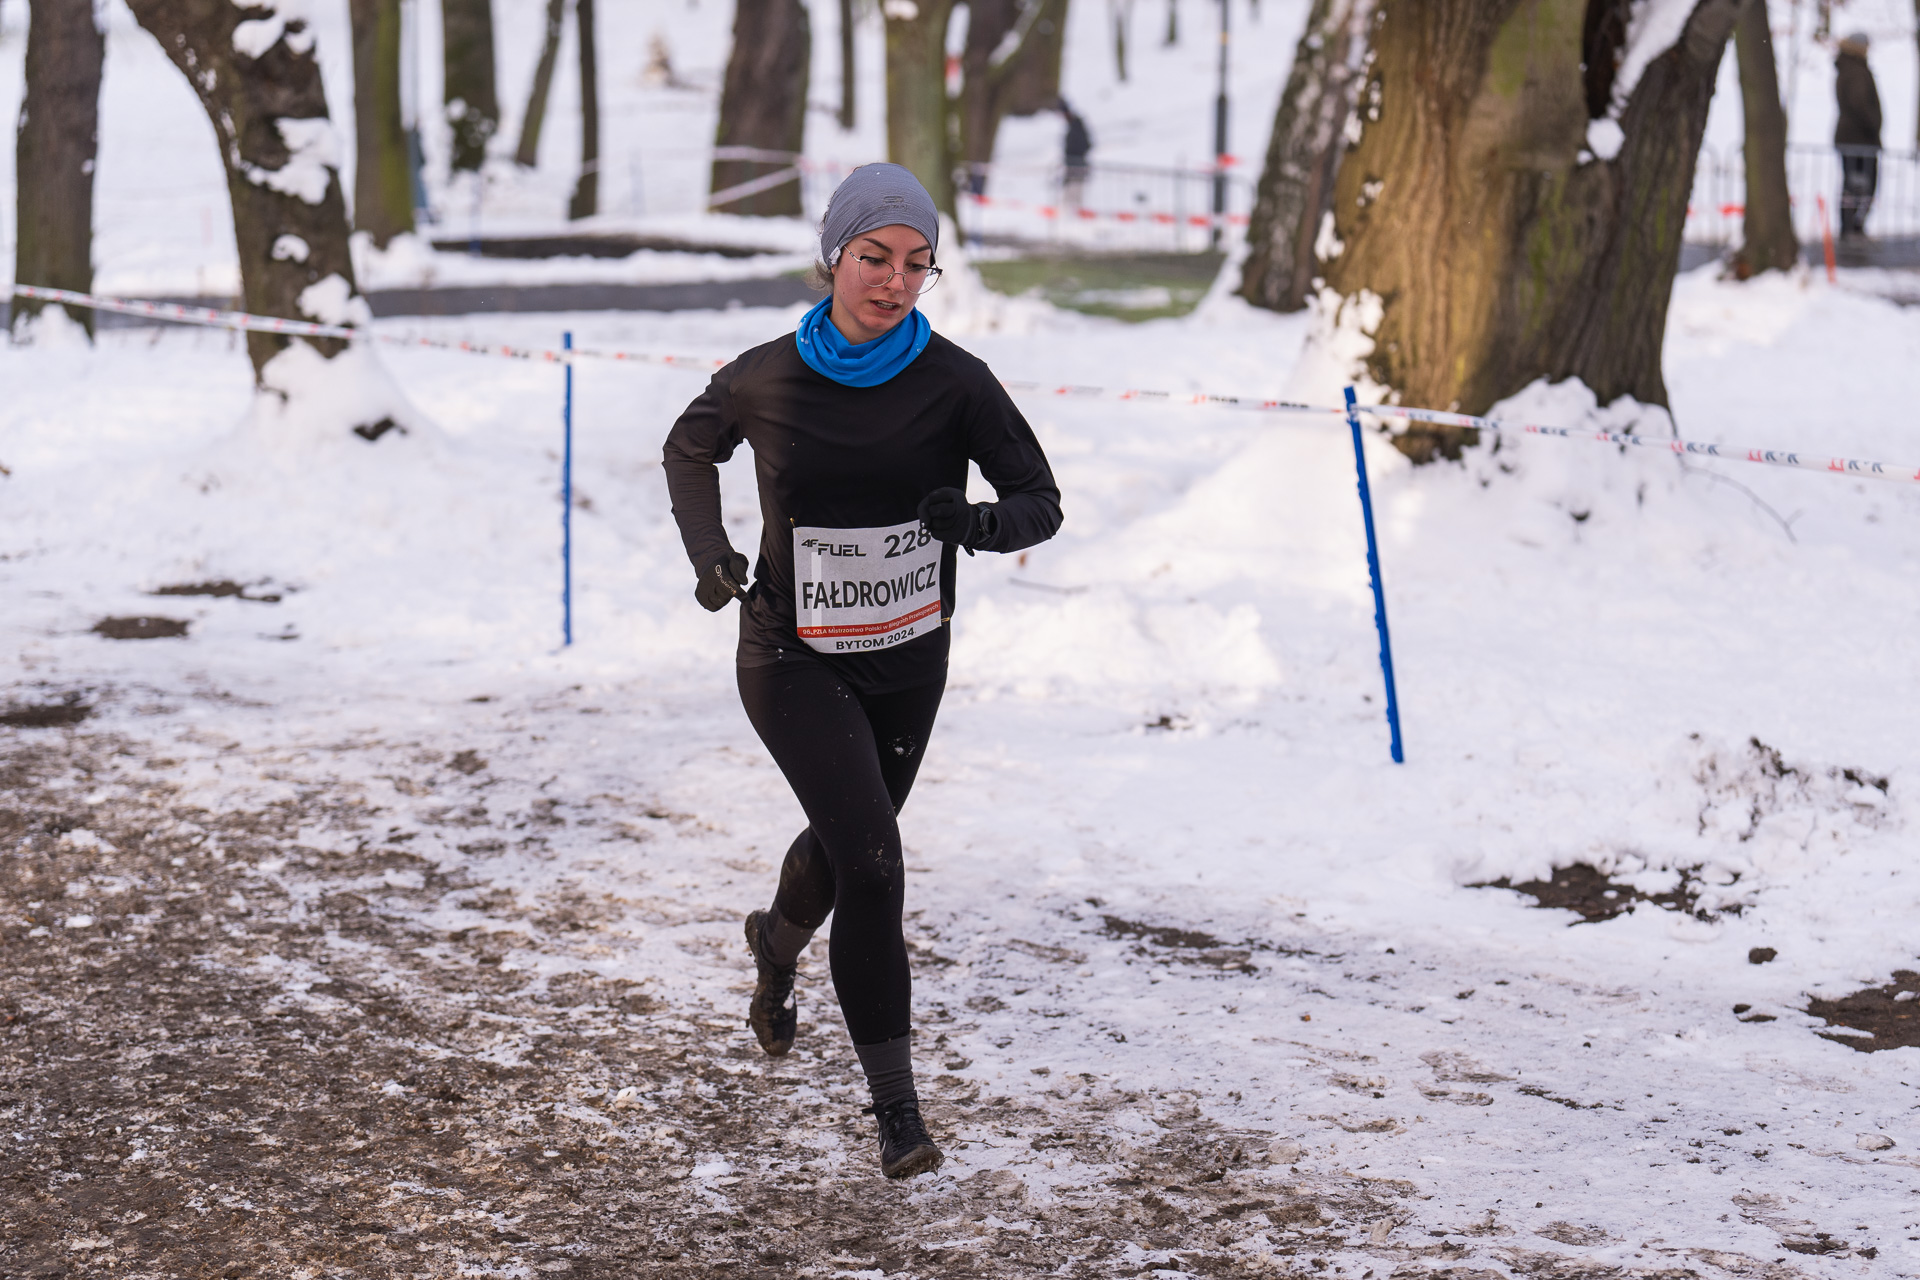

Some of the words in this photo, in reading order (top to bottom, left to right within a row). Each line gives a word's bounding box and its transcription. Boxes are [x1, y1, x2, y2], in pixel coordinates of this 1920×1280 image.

[818, 543, 867, 557] FUEL
[884, 527, 931, 559] 228
[802, 562, 937, 610] FAŁDROWICZ
[836, 637, 885, 651] BYTOM
[887, 627, 915, 645] 2024
